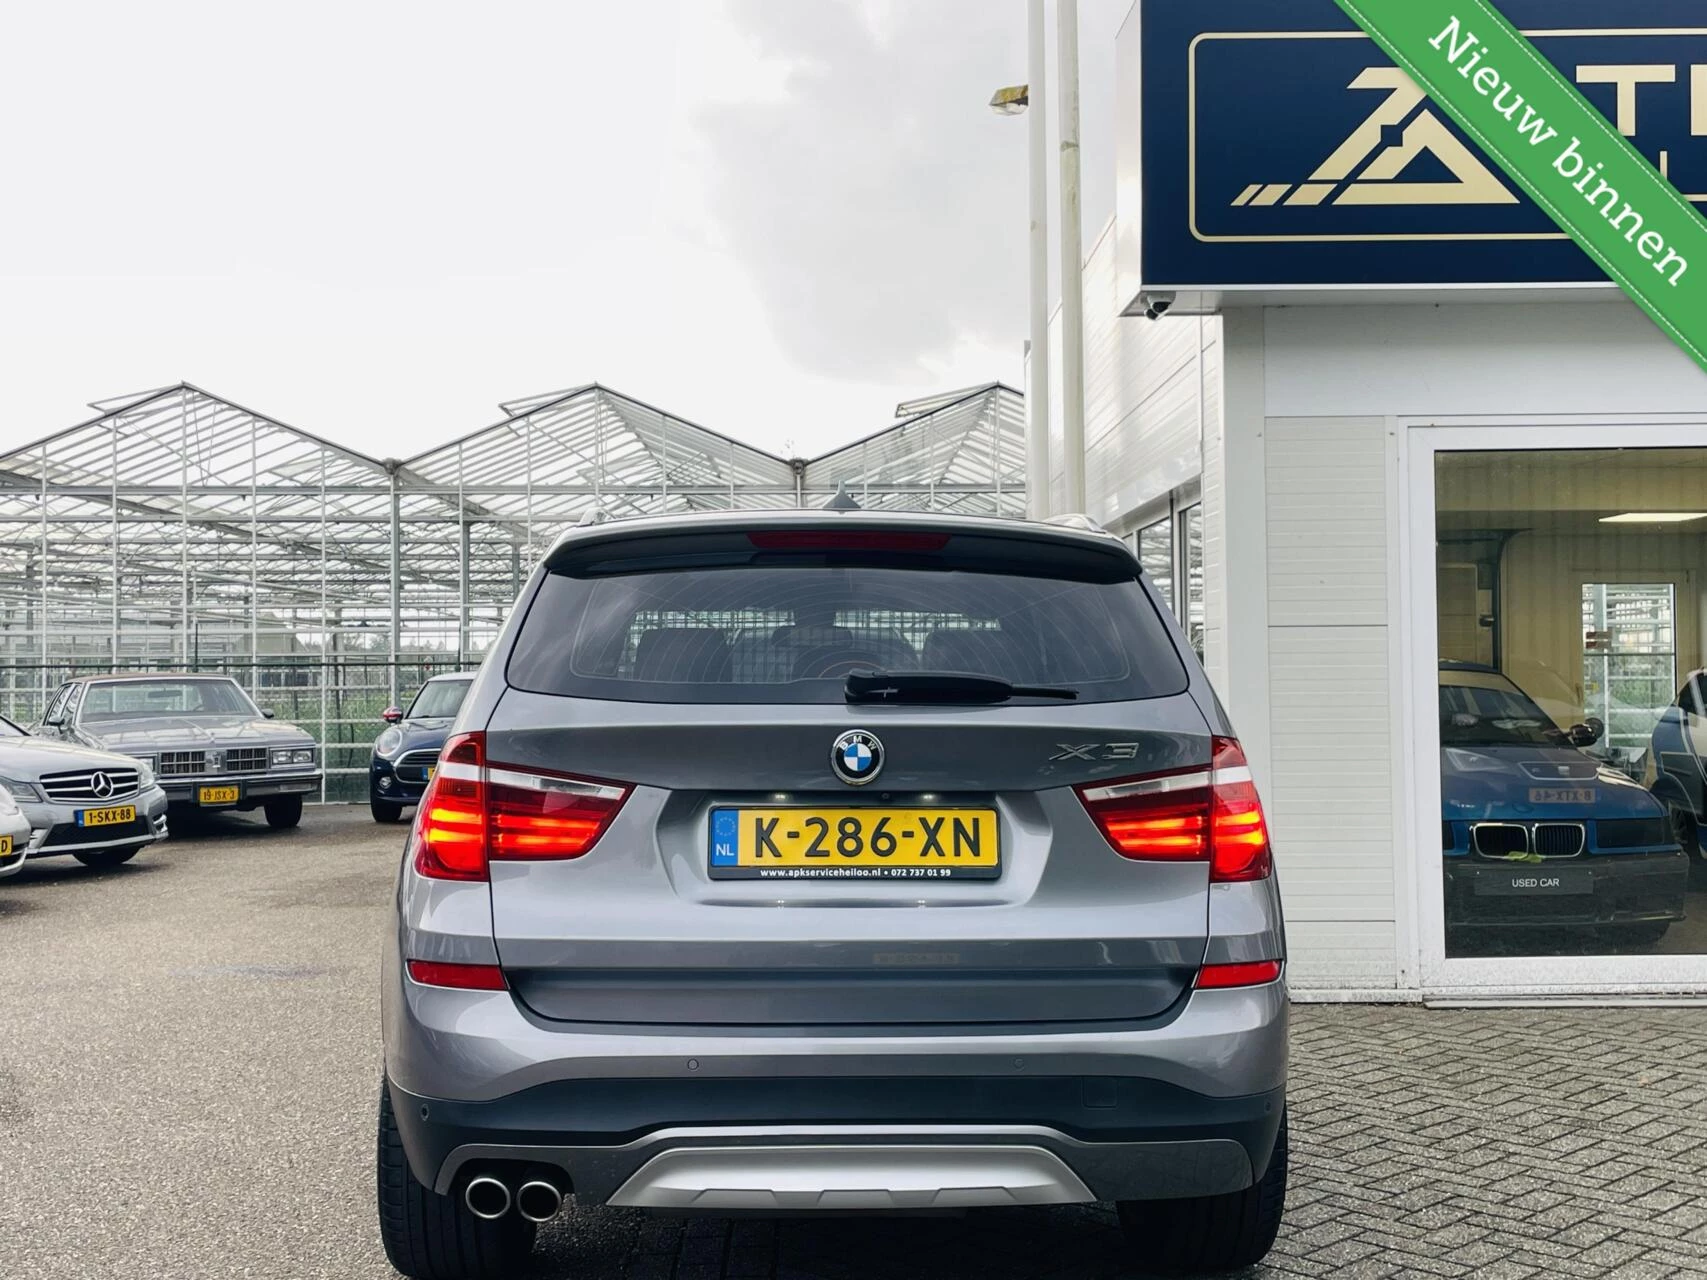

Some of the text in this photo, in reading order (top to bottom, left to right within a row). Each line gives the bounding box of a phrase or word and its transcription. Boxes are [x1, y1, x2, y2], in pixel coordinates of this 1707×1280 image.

[839, 735, 877, 751] BMW
[1048, 742, 1139, 761] X3
[89, 808, 131, 824] 1-SKX-88
[755, 816, 981, 858] K-286-XN
[715, 843, 735, 857] NL
[760, 867, 951, 878] www.apkserviceheiloo.nl 072 737 01 99
[1511, 878, 1560, 888] USED CAR
